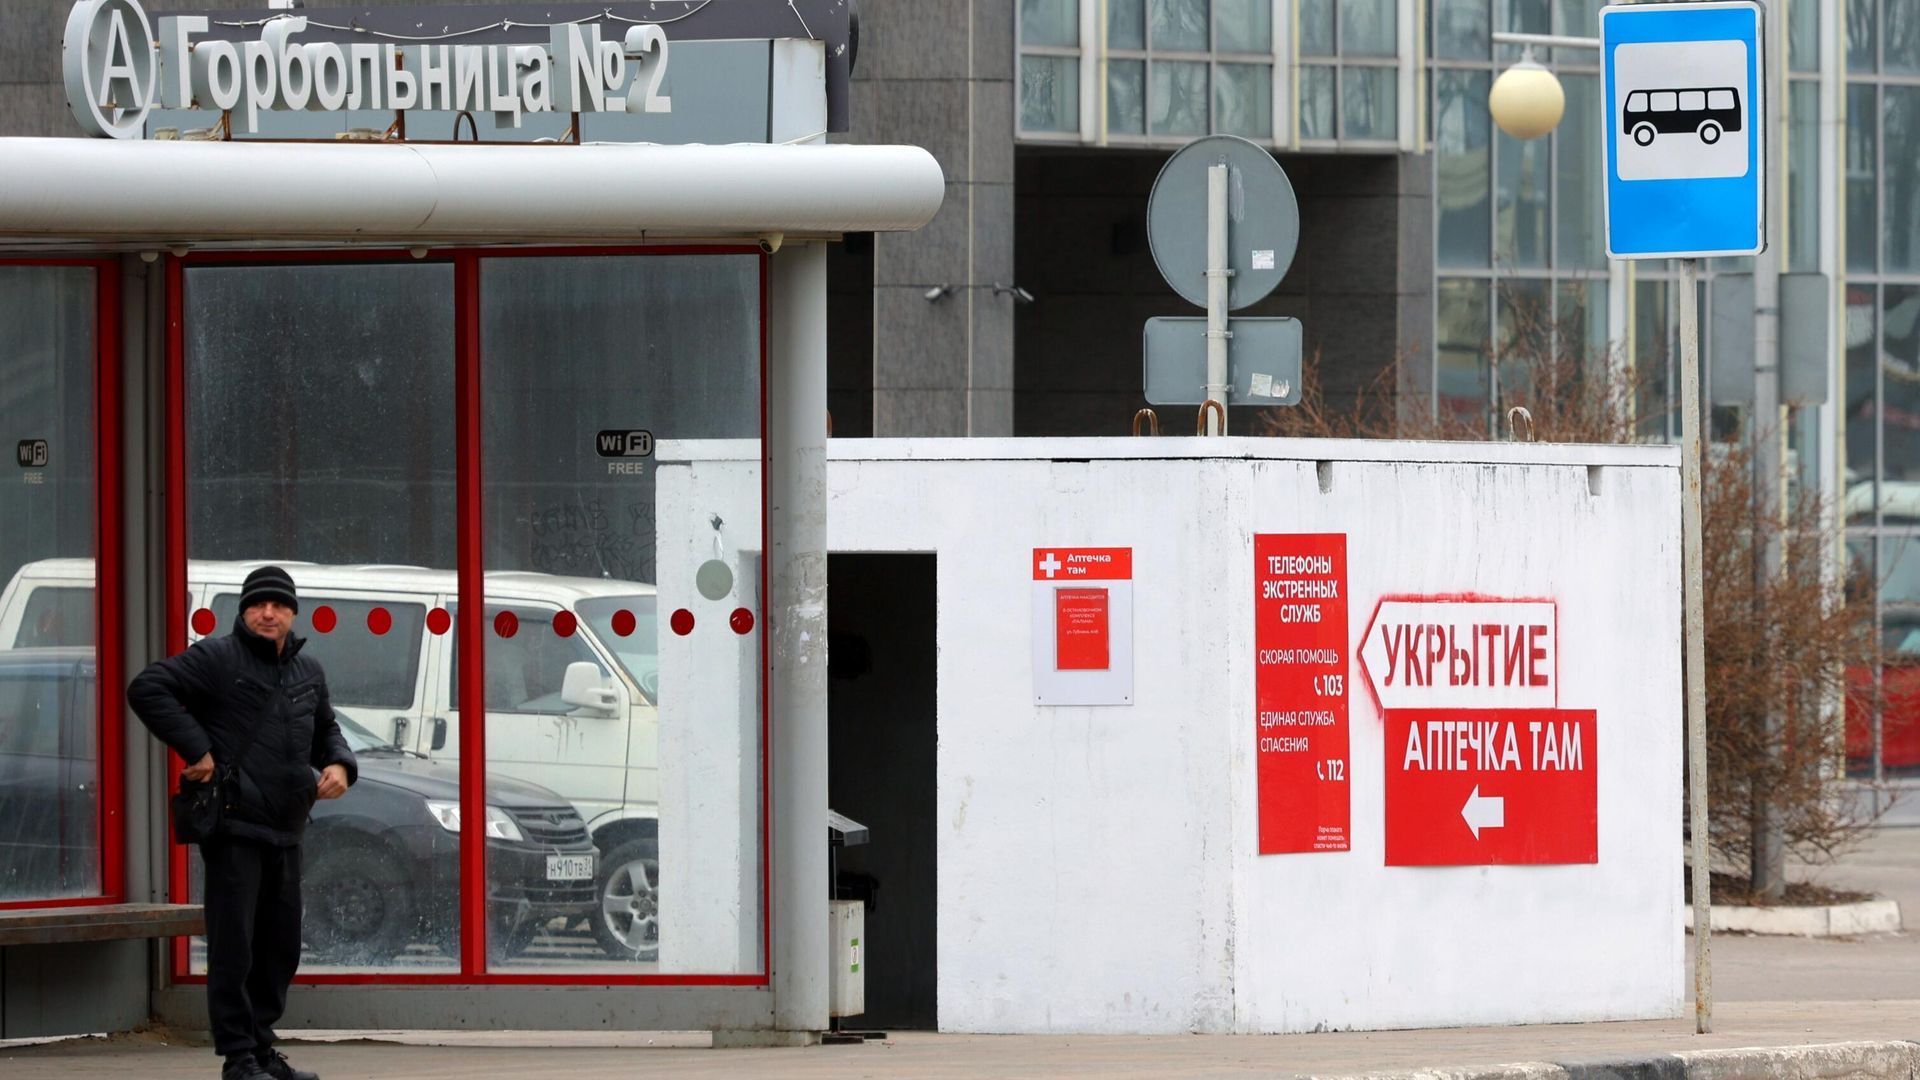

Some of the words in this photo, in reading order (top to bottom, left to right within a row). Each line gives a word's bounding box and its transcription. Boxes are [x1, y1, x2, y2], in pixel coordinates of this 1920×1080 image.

[160, 16, 552, 133] Горбольница
[608, 462, 643, 474] FREE
[1066, 553, 1112, 564] Аптечка
[1267, 555, 1332, 575] ТЕЛЕФОНЫ
[1066, 565, 1087, 575] там
[1262, 580, 1338, 599] ЭКСТРЕННЫХ
[1280, 604, 1322, 623] СЛУЖБ
[1260, 649, 1295, 665] СКОРАЯ
[1296, 649, 1339, 667] ПОМОЩЬ
[1381, 624, 1549, 687] УКРЫТИЕ
[1323, 675, 1343, 696] 103
[1260, 711, 1297, 728] ЕДИНАЯ
[1298, 710, 1335, 726] СЛУЖБА
[1260, 737, 1309, 753] СПАСЕНИЯ
[1403, 720, 1522, 771] АПТЕЧКА
[1529, 721, 1583, 771] ТАМ
[1326, 759, 1344, 781] 112
